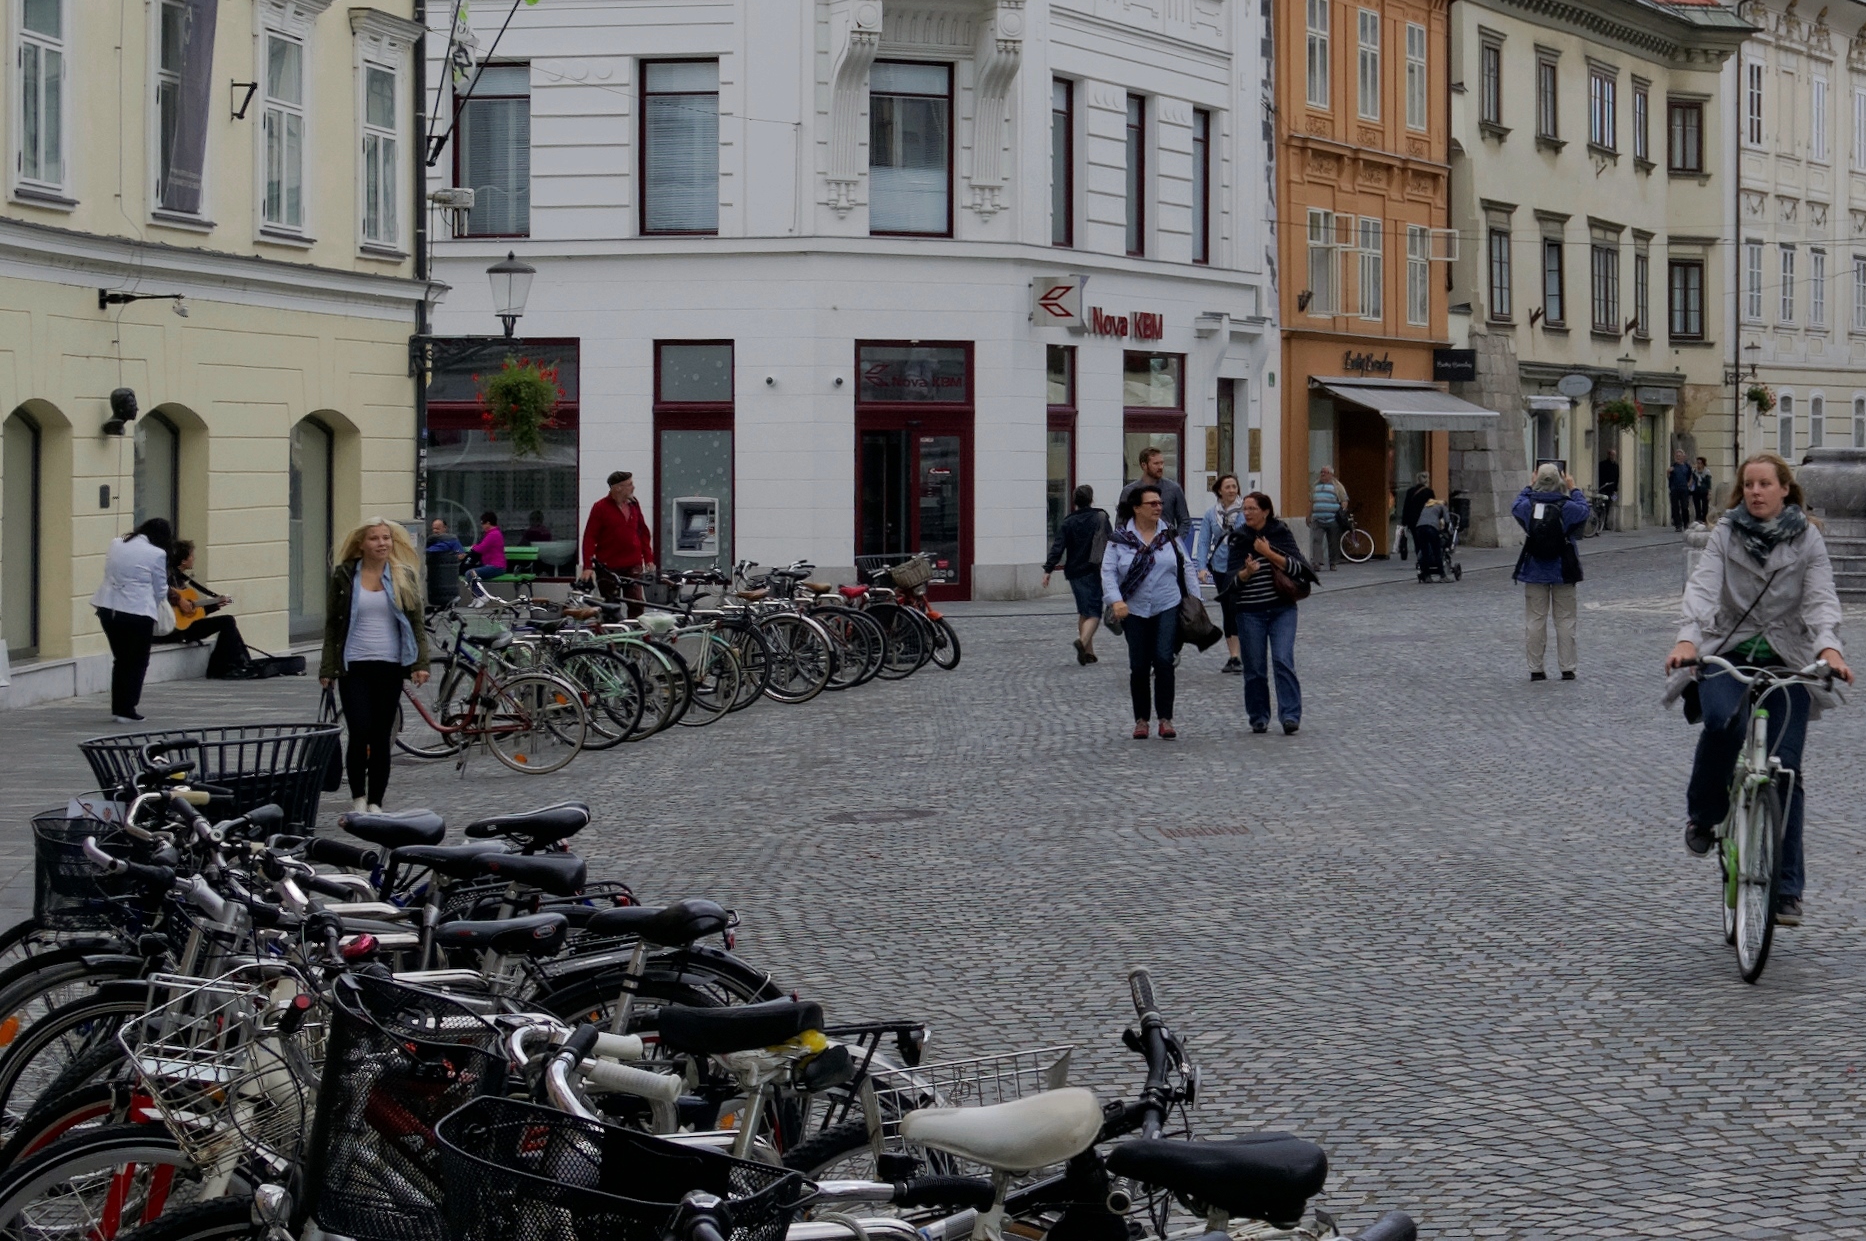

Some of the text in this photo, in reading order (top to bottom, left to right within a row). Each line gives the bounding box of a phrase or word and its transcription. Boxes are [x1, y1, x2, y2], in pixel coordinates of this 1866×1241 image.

[1092, 306, 1163, 340] Nova KBM
[891, 377, 962, 388] Nova KBM
